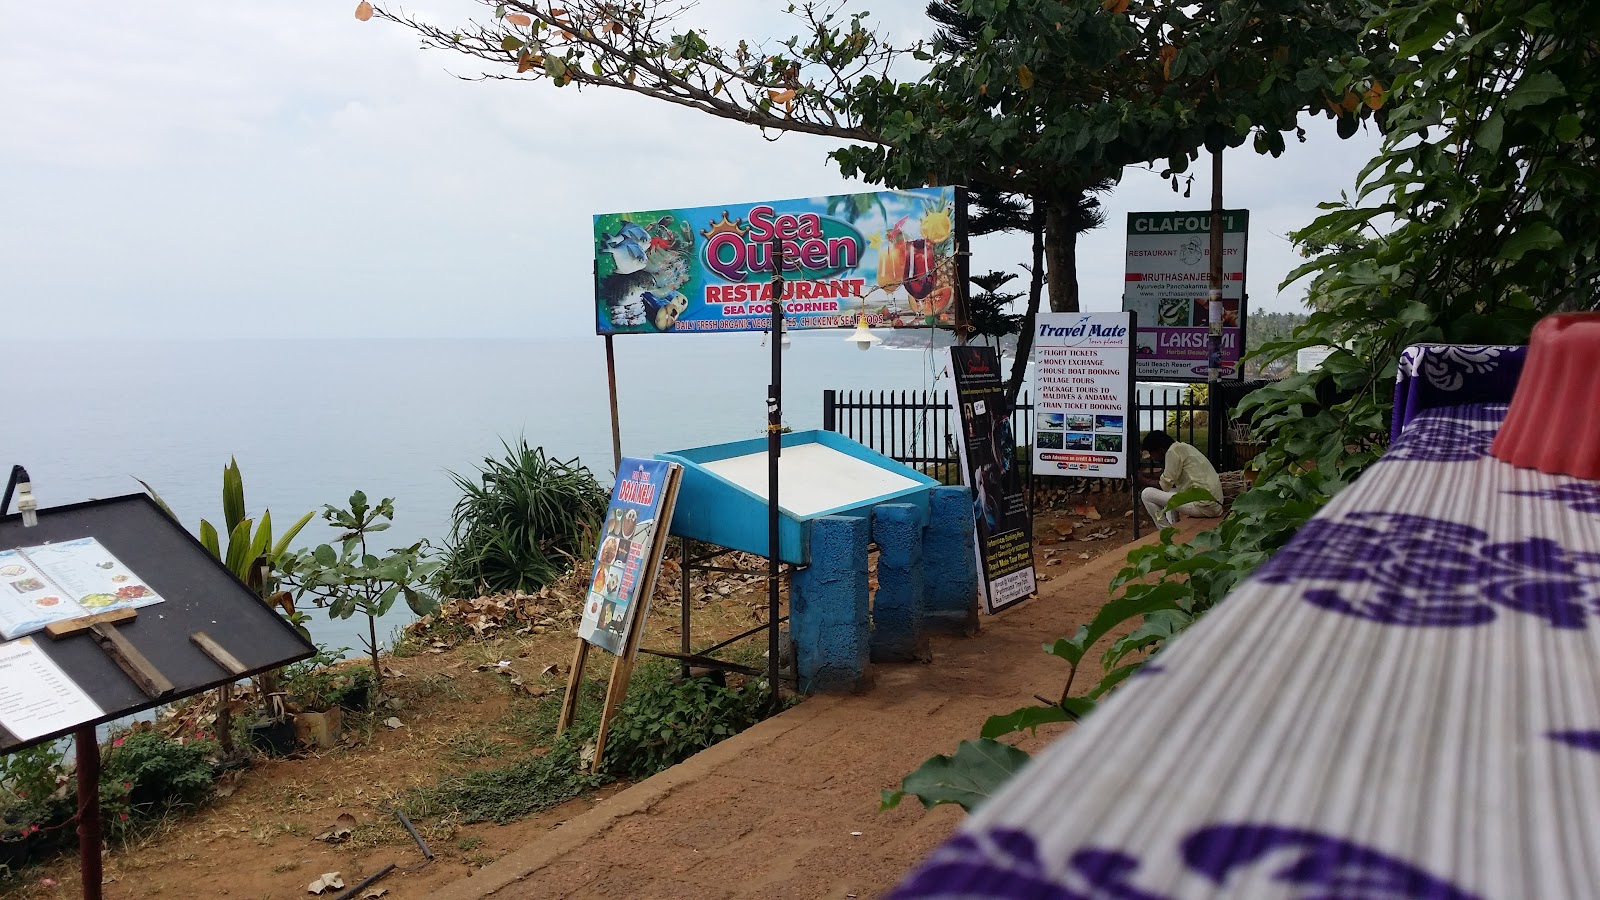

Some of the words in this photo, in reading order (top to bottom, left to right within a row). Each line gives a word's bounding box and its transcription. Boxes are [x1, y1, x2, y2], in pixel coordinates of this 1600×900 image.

[749, 205, 822, 242] Sea
[1135, 216, 1233, 231] CLAFOUI
[706, 232, 858, 283] Queen
[706, 279, 864, 303] RESTAURANT
[723, 306, 745, 314] SEA
[749, 304, 773, 313] FOO
[787, 302, 838, 312] CORNER
[675, 321, 695, 330] DAILY
[696, 320, 717, 330] FRESH
[720, 319, 751, 329] ORGANIC
[800, 316, 832, 326] CHICKEN
[832, 316, 838, 326] &
[840, 316, 853, 325] SEA
[856, 314, 883, 325] FODS
[1040, 324, 1086, 337] Travel
[1088, 324, 1126, 337] Mate
